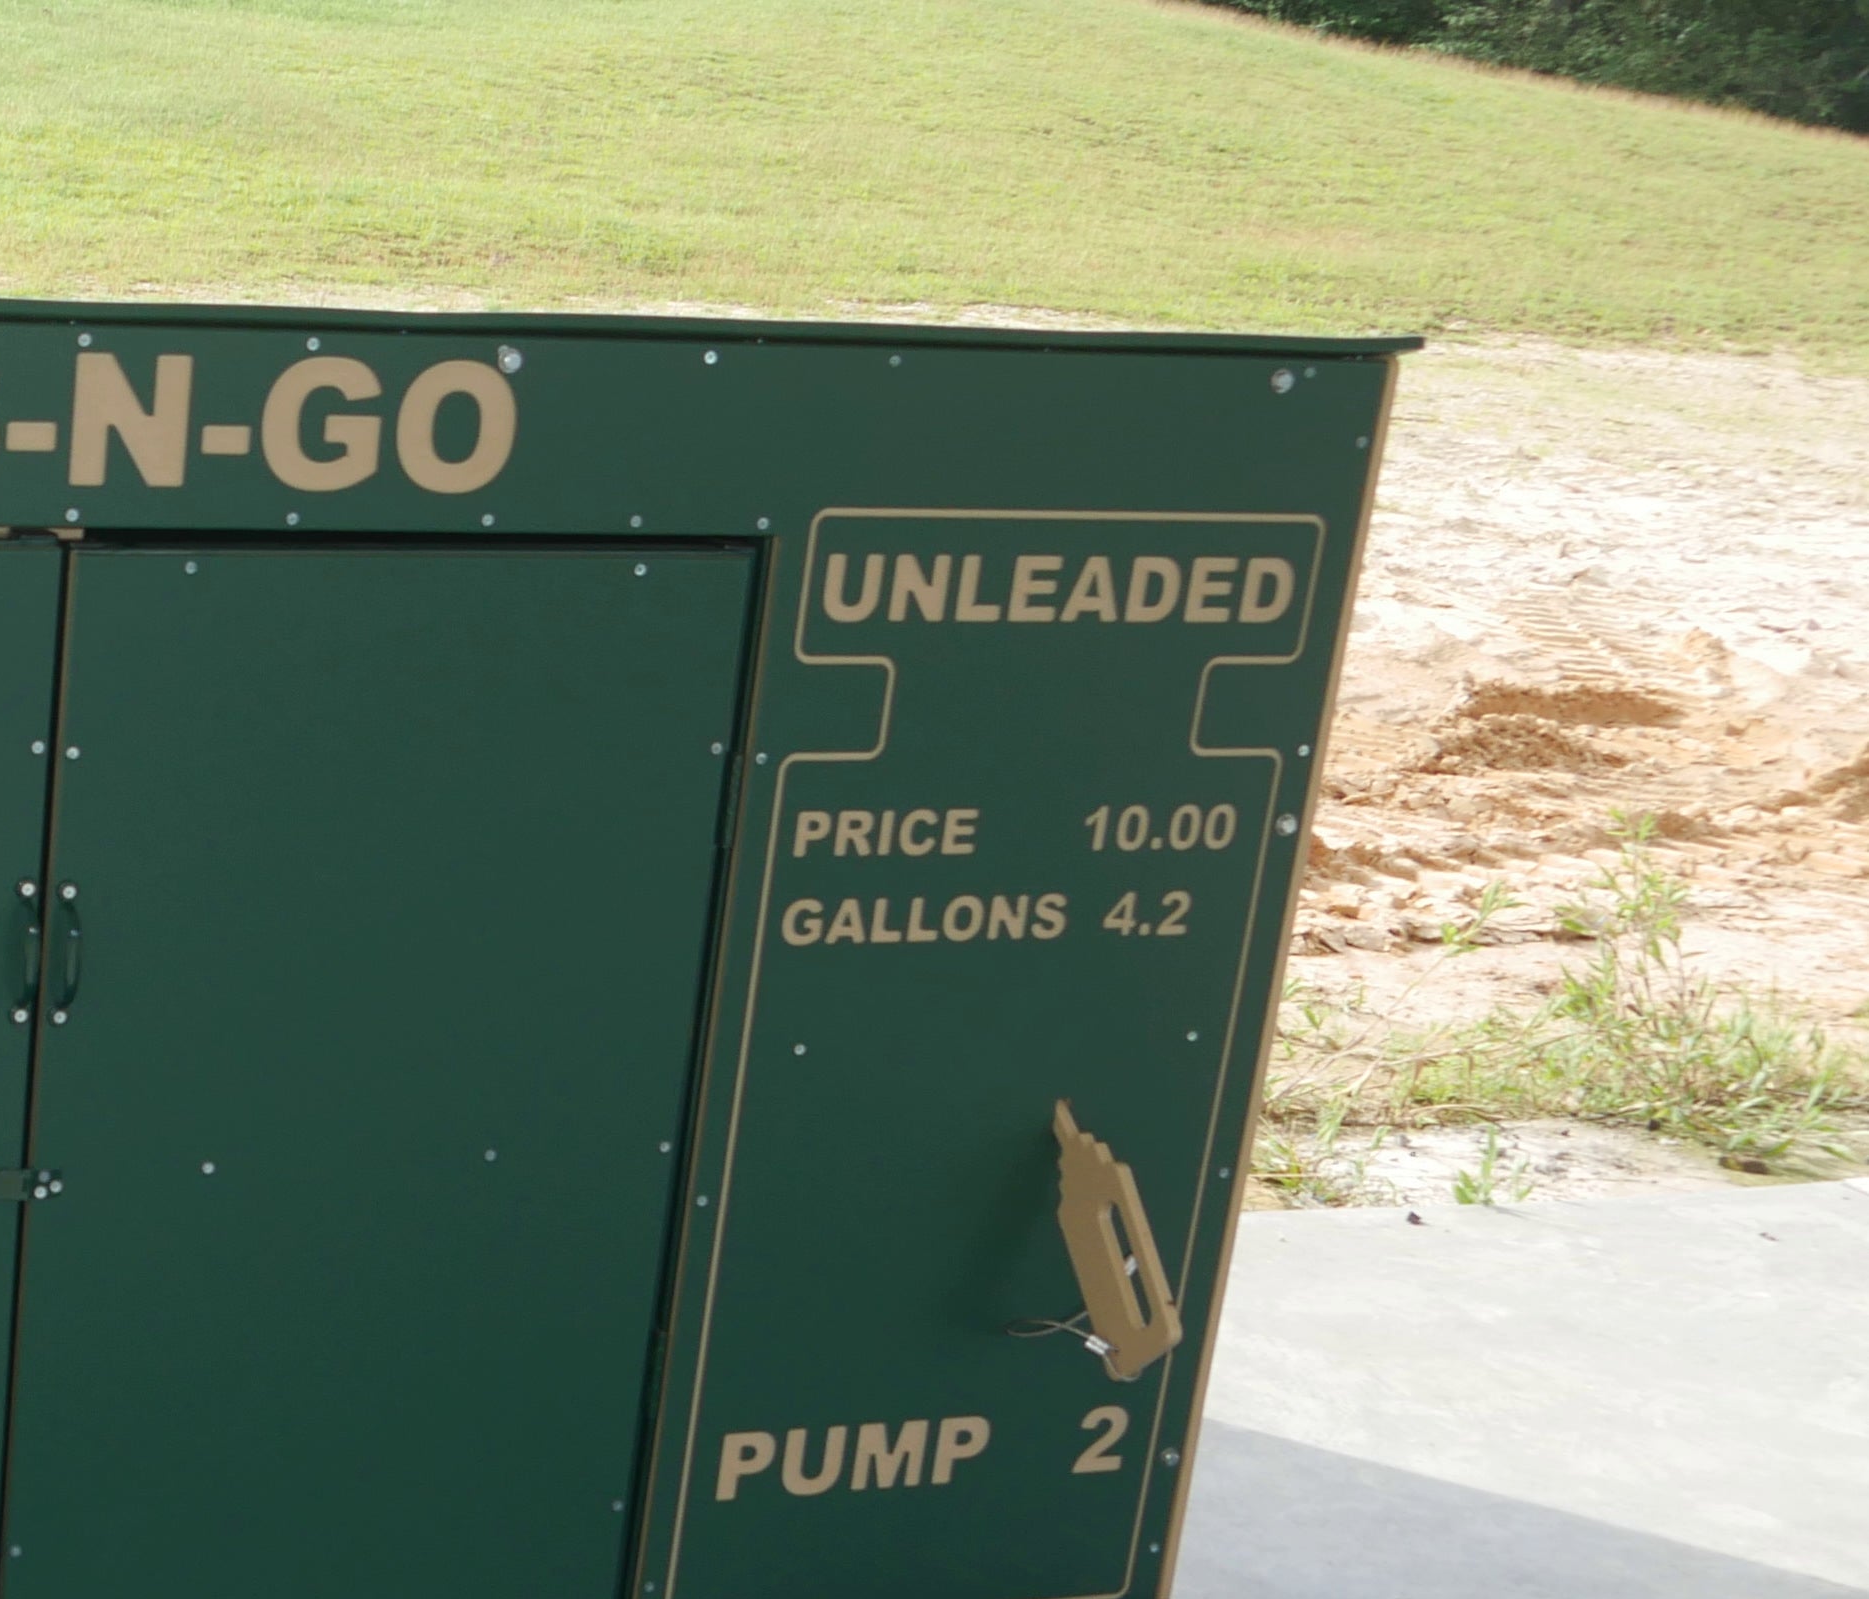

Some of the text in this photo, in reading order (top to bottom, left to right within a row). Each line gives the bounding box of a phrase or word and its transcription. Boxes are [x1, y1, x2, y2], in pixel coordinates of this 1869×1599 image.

[824, 554, 1292, 622] UNLEADED
[794, 805, 1236, 856] PRICE 10.00
[783, 891, 1189, 946] GALLONS 4.2
[716, 1407, 1128, 1500] PUMP 2
